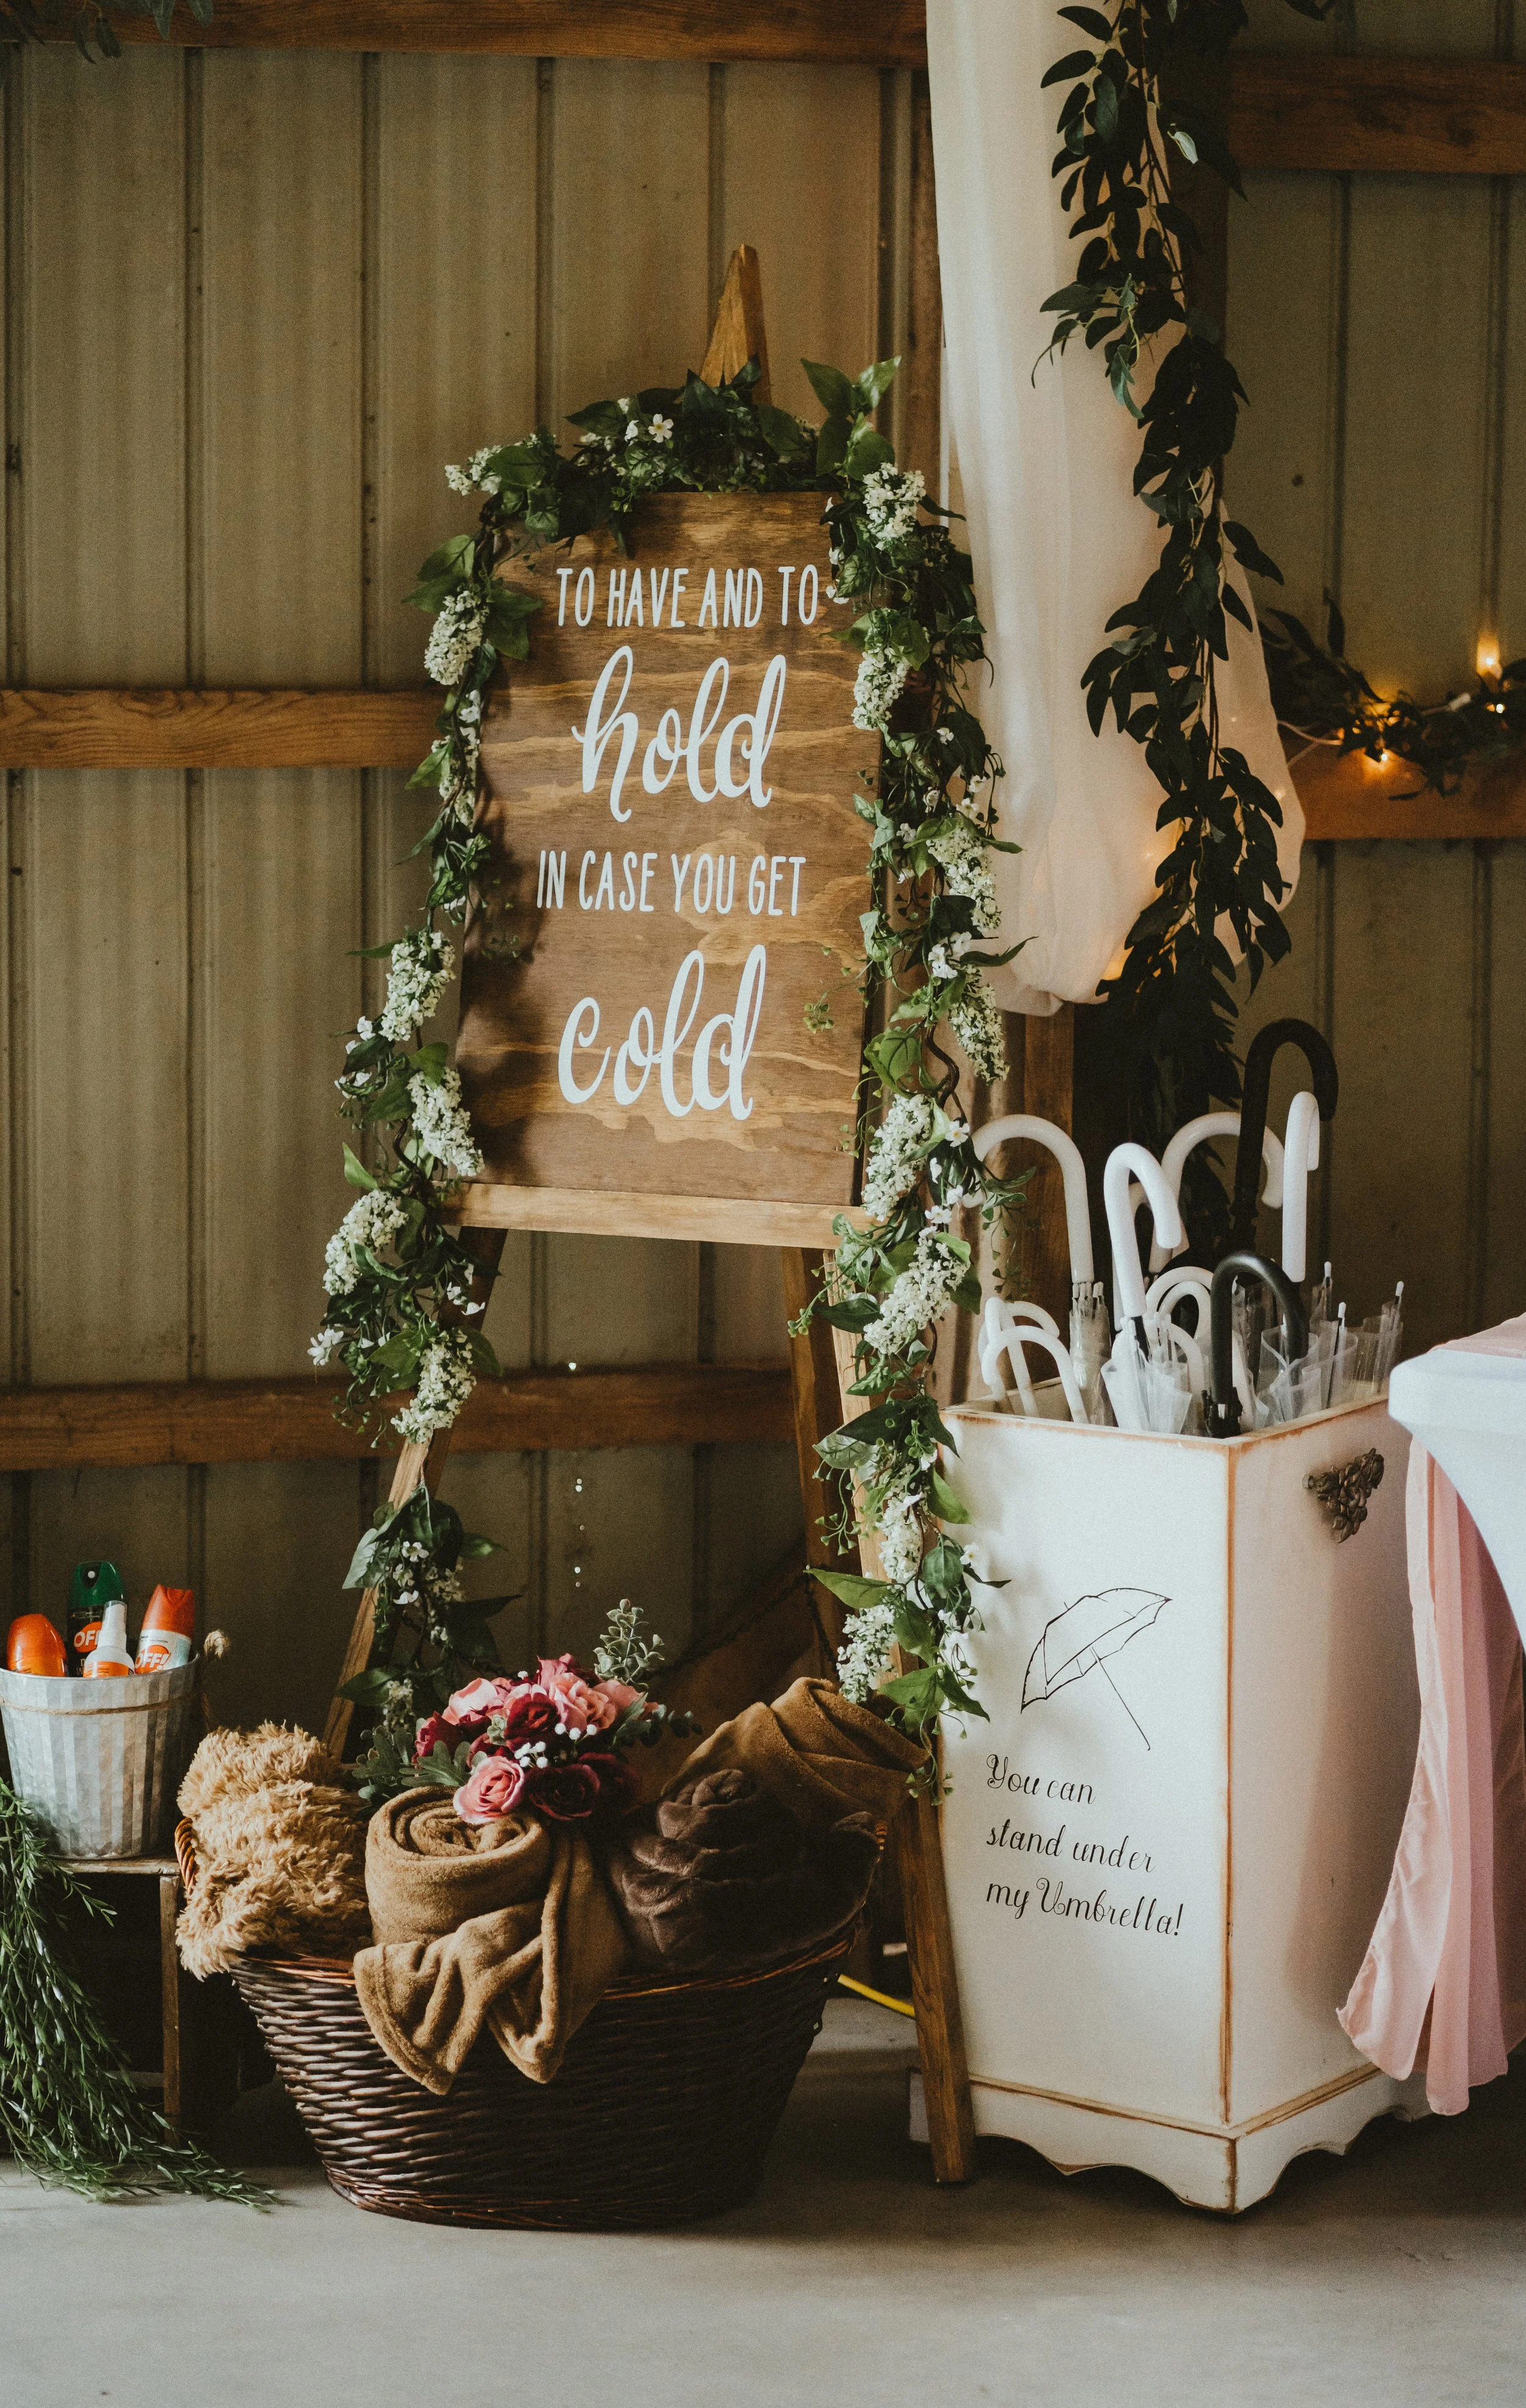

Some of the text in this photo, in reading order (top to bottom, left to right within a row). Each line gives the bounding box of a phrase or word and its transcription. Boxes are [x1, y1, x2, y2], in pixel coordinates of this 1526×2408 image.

[557, 564, 819, 628] TO HAVE AND TO
[571, 645, 786, 823] hold
[537, 850, 806, 917] IN CASE YOU GET
[558, 945, 766, 1120] cold
[135, 1652, 171, 1671] OFF!
[986, 1754, 1096, 1804] You can
[986, 1819, 1156, 1873] stand under
[986, 1878, 1184, 1936] my Umbrella!
